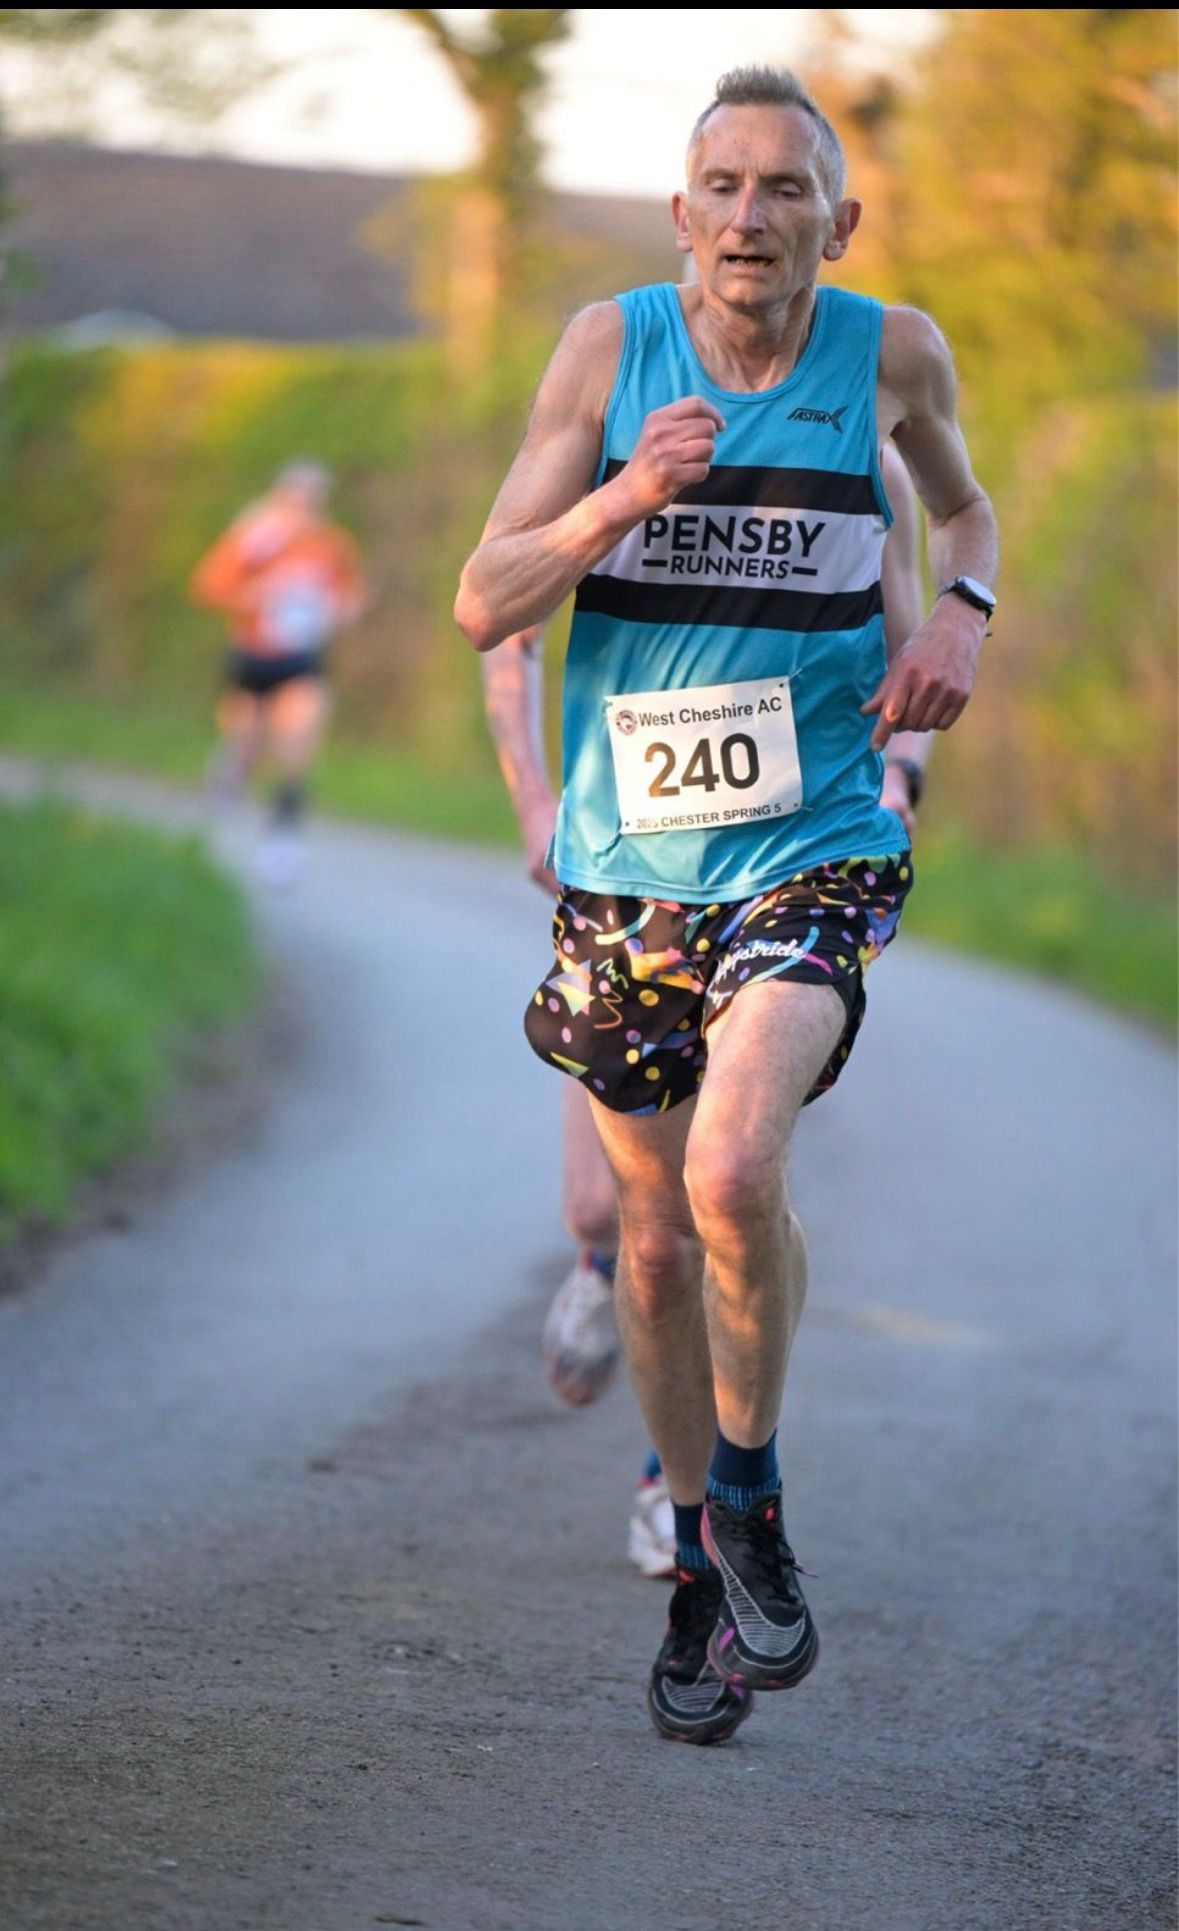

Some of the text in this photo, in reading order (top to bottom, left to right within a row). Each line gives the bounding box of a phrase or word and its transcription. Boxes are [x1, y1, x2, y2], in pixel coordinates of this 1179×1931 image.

[644, 514, 825, 557] PENSBY
[670, 556, 792, 579] RUNNERS
[638, 711, 675, 727] West
[679, 703, 753, 723] Cheshire
[757, 696, 782, 714] AC
[644, 732, 760, 798] 240
[660, 812, 720, 827] CHESTER
[723, 804, 771, 821] SPRING
[774, 802, 782, 813] 5
